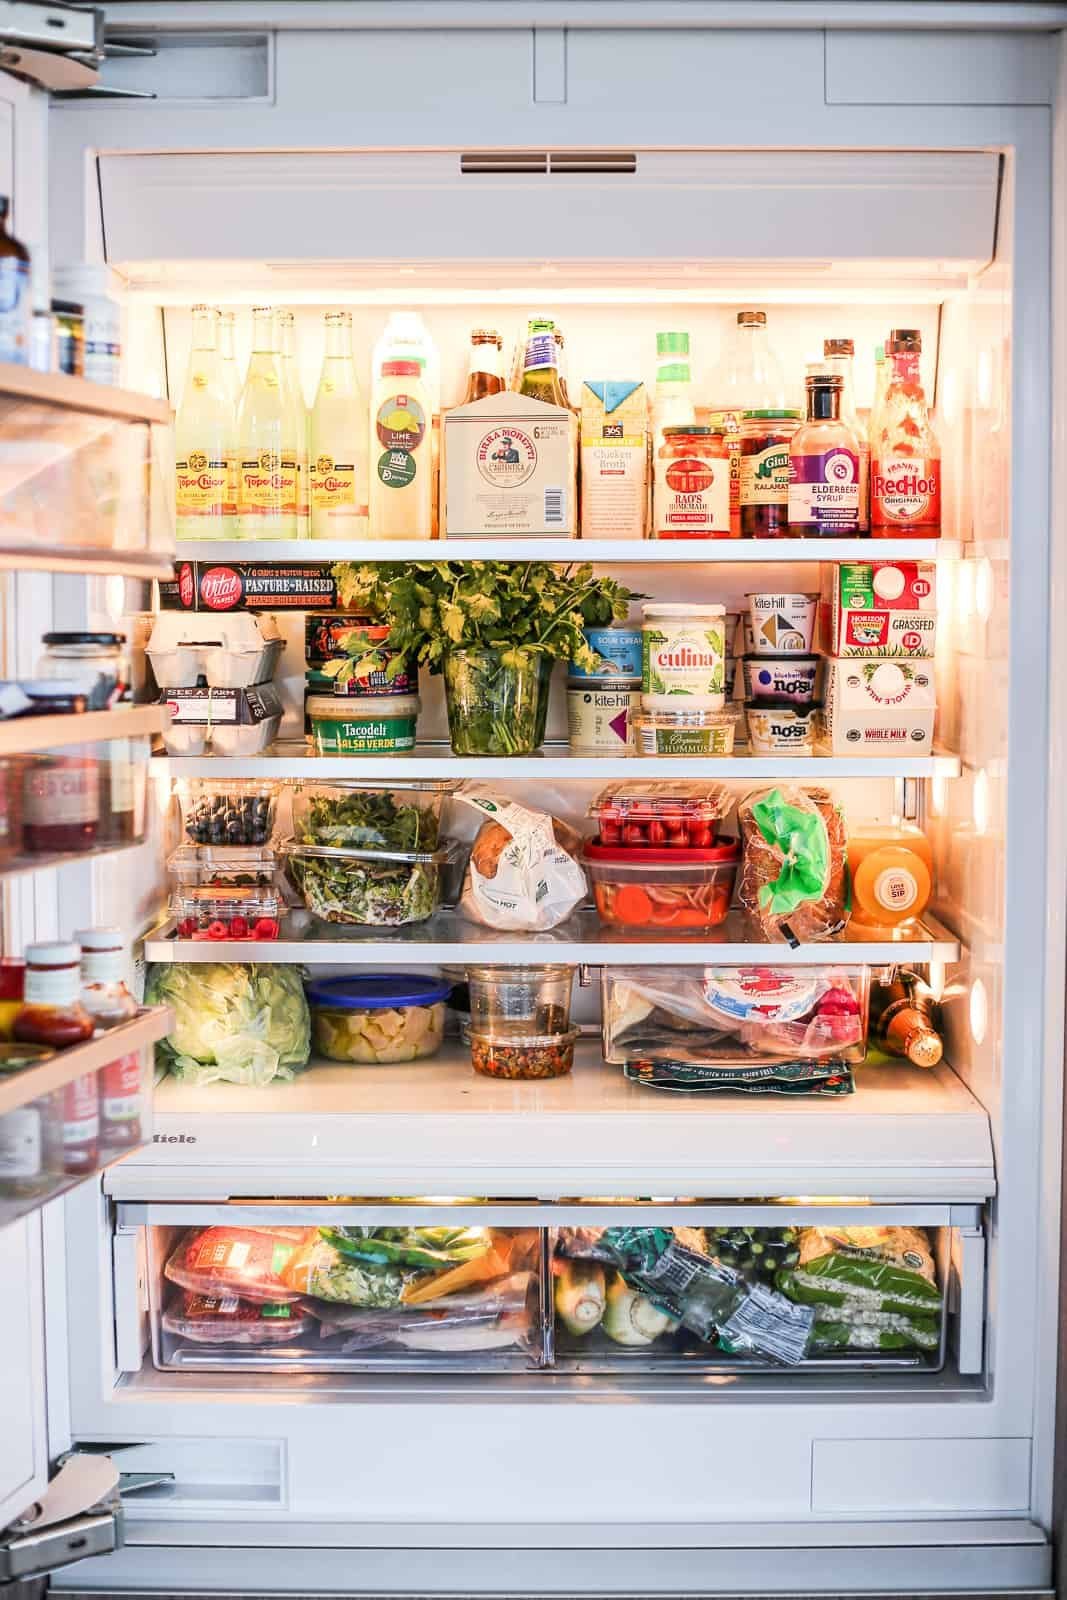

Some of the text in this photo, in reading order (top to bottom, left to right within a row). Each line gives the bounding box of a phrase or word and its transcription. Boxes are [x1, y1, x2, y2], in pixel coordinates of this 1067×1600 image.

[532, 426, 541, 440] 6
[479, 429, 536, 461] BIRRA MORETTI
[593, 448, 632, 459] Chicken
[599, 459, 625, 469] Broth
[244, 473, 271, 489] Topo
[324, 476, 352, 492] Chico
[873, 474, 937, 497] RedHot
[674, 494, 703, 504] RAO'S
[816, 494, 843, 502] SYRUP
[205, 573, 237, 599] Vital
[245, 578, 334, 593] PASTURE-RAISED
[772, 596, 785, 609] hill
[850, 615, 886, 624] HORIZON
[892, 619, 934, 631] GRASSFED
[657, 647, 713, 668] culina
[594, 694, 630, 707] kite hill
[342, 722, 387, 737] Tacodeli
[864, 730, 907, 739] WHOLE MILK
[366, 738, 396, 748] VERDE
[664, 744, 709, 754] HUMMUS
[891, 890, 905, 898] SIP
